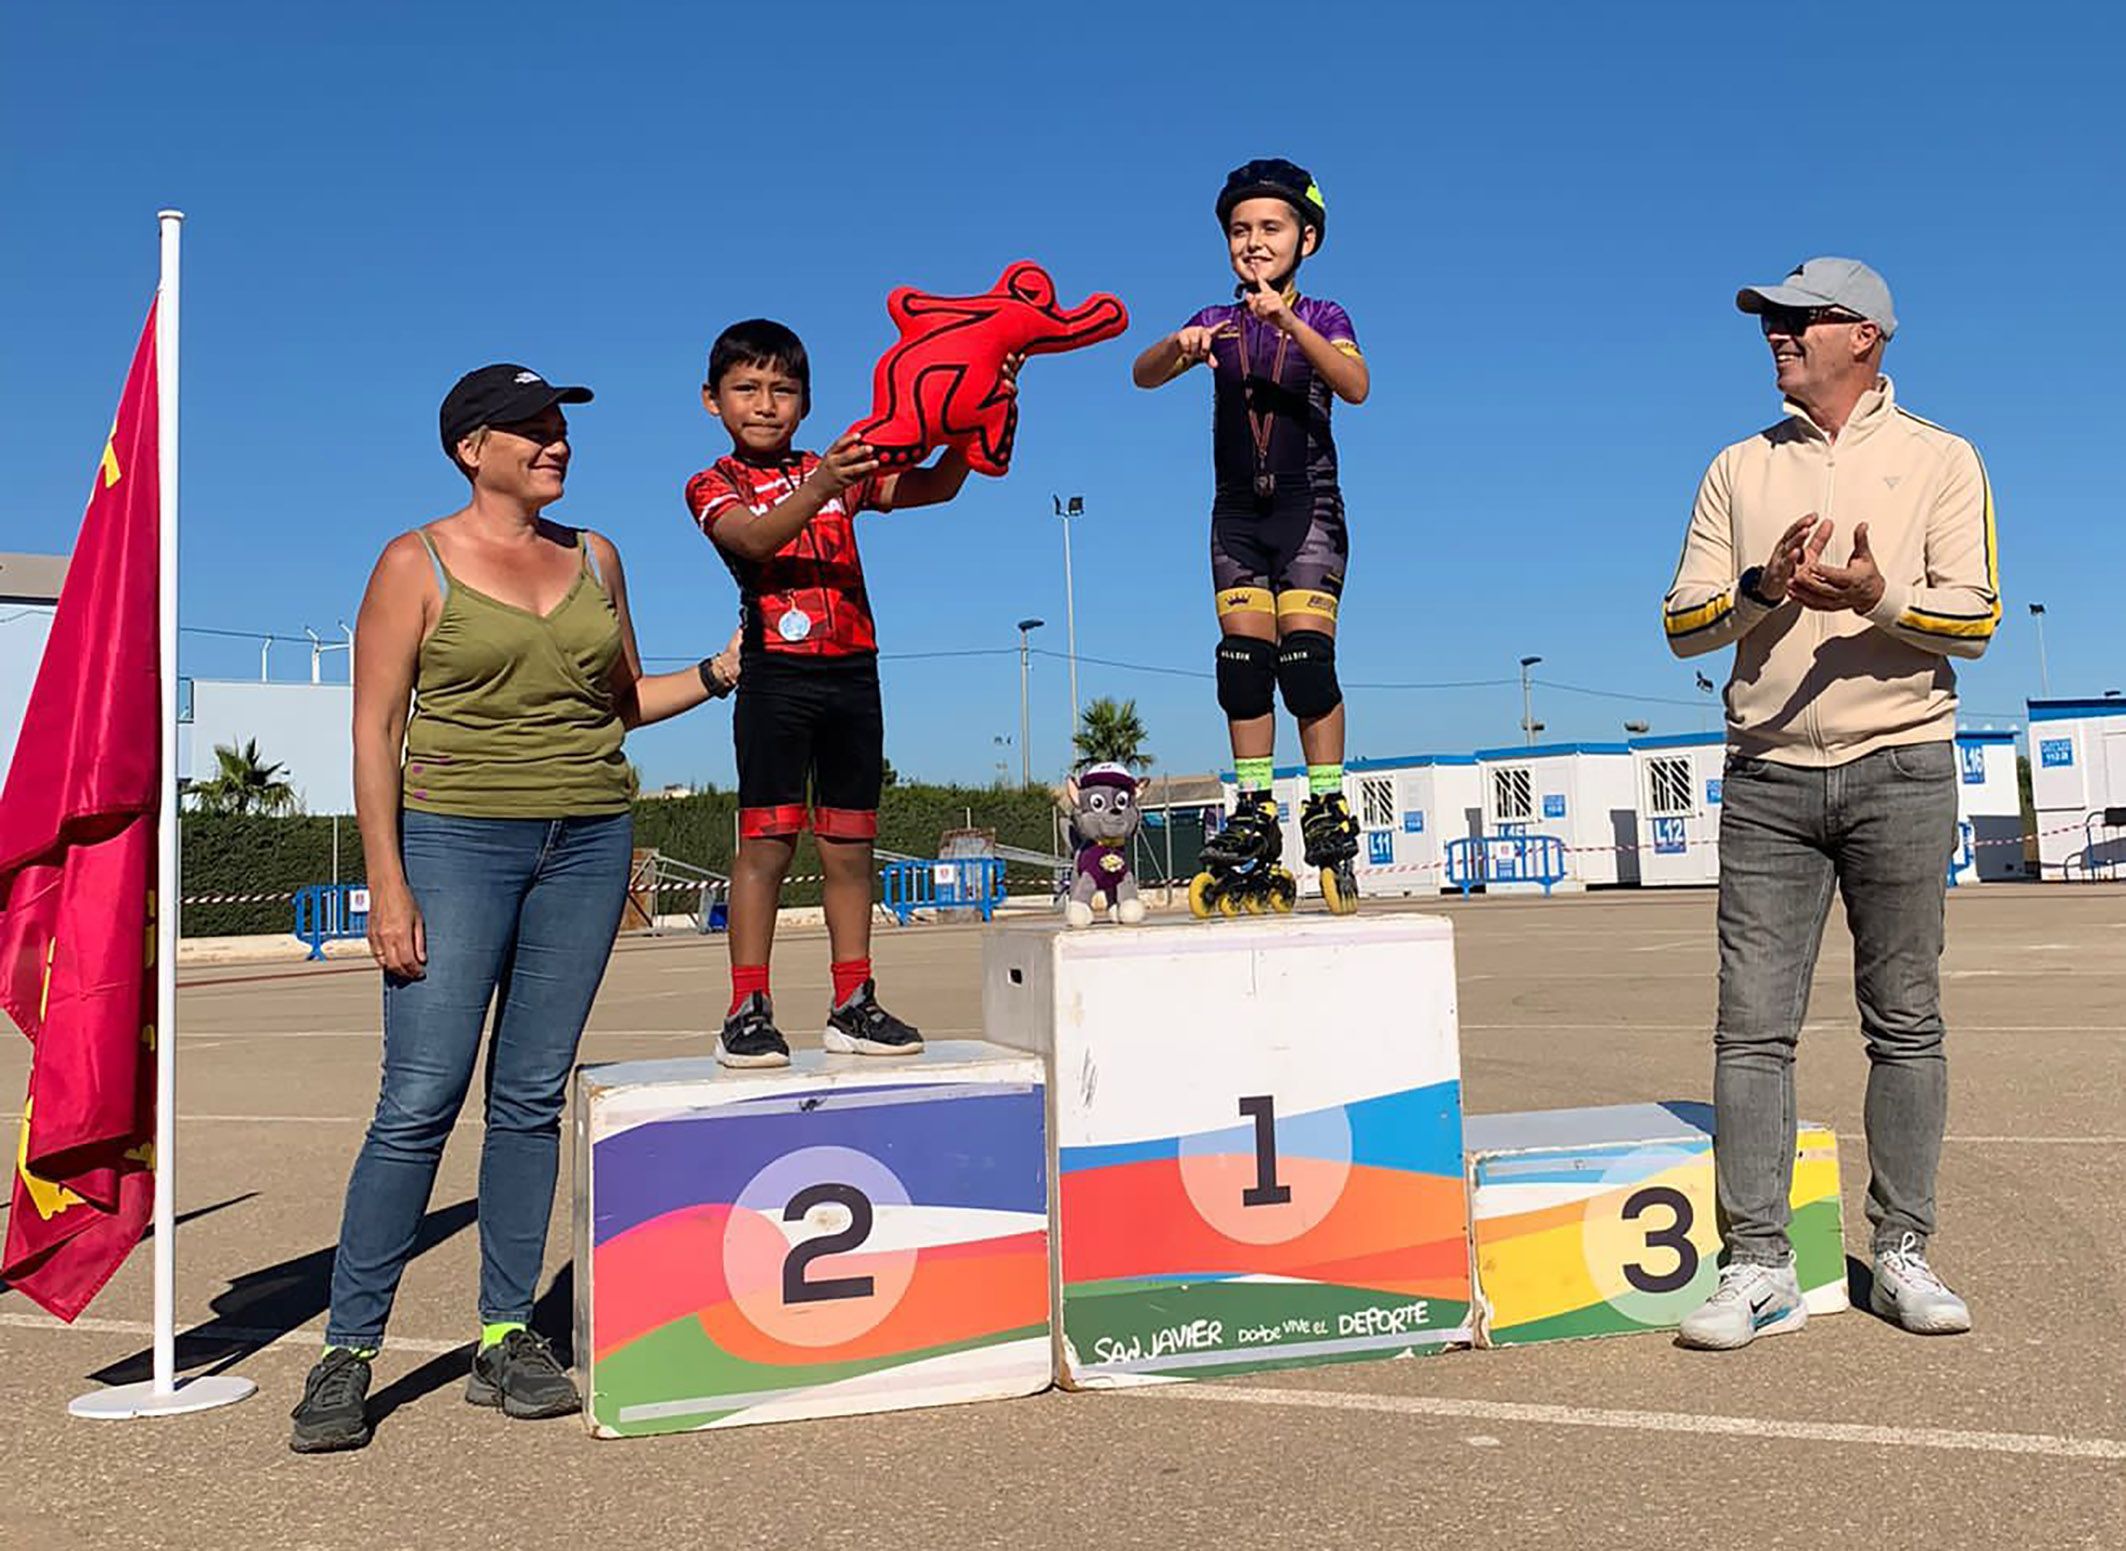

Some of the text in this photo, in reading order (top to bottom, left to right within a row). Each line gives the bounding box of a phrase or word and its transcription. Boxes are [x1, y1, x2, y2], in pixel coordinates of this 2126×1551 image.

[1370, 832, 1390, 855] L11
[1655, 818, 1684, 843] L12
[1239, 1095, 1291, 1207] 1
[783, 1182, 874, 1304] 2
[1621, 1186, 1699, 1293] 3
[1094, 1336, 1141, 1366] SAN
[1143, 1319, 1223, 1360] JAVIER
[1338, 1300, 1430, 1336] DEPORTE
